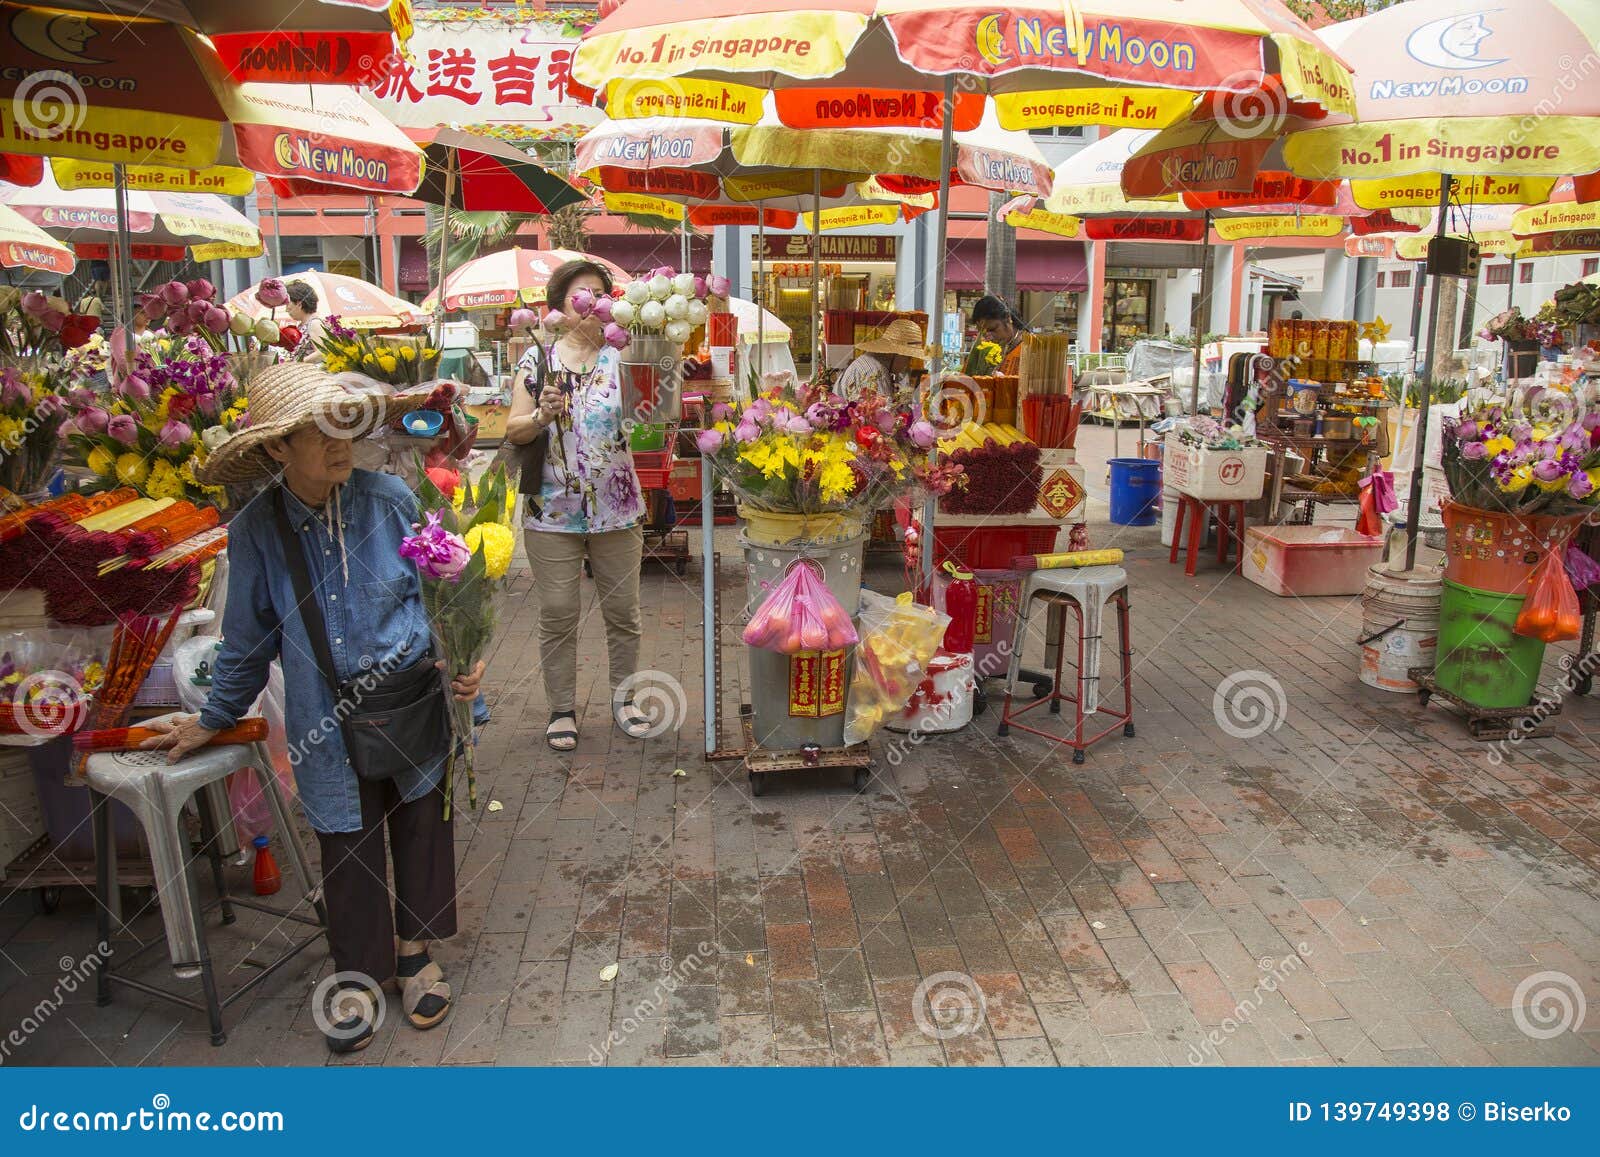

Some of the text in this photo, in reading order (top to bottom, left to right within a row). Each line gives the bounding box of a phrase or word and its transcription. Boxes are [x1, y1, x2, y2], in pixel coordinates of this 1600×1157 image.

[667, 45, 685, 63] in
[689, 36, 811, 58] Singapore
[13, 121, 187, 154] in Singapore
[1399, 143, 1420, 160] in
[1426, 139, 1560, 163] Singapore
[820, 237, 878, 255] NANYANG
[1222, 464, 1242, 478] CT
